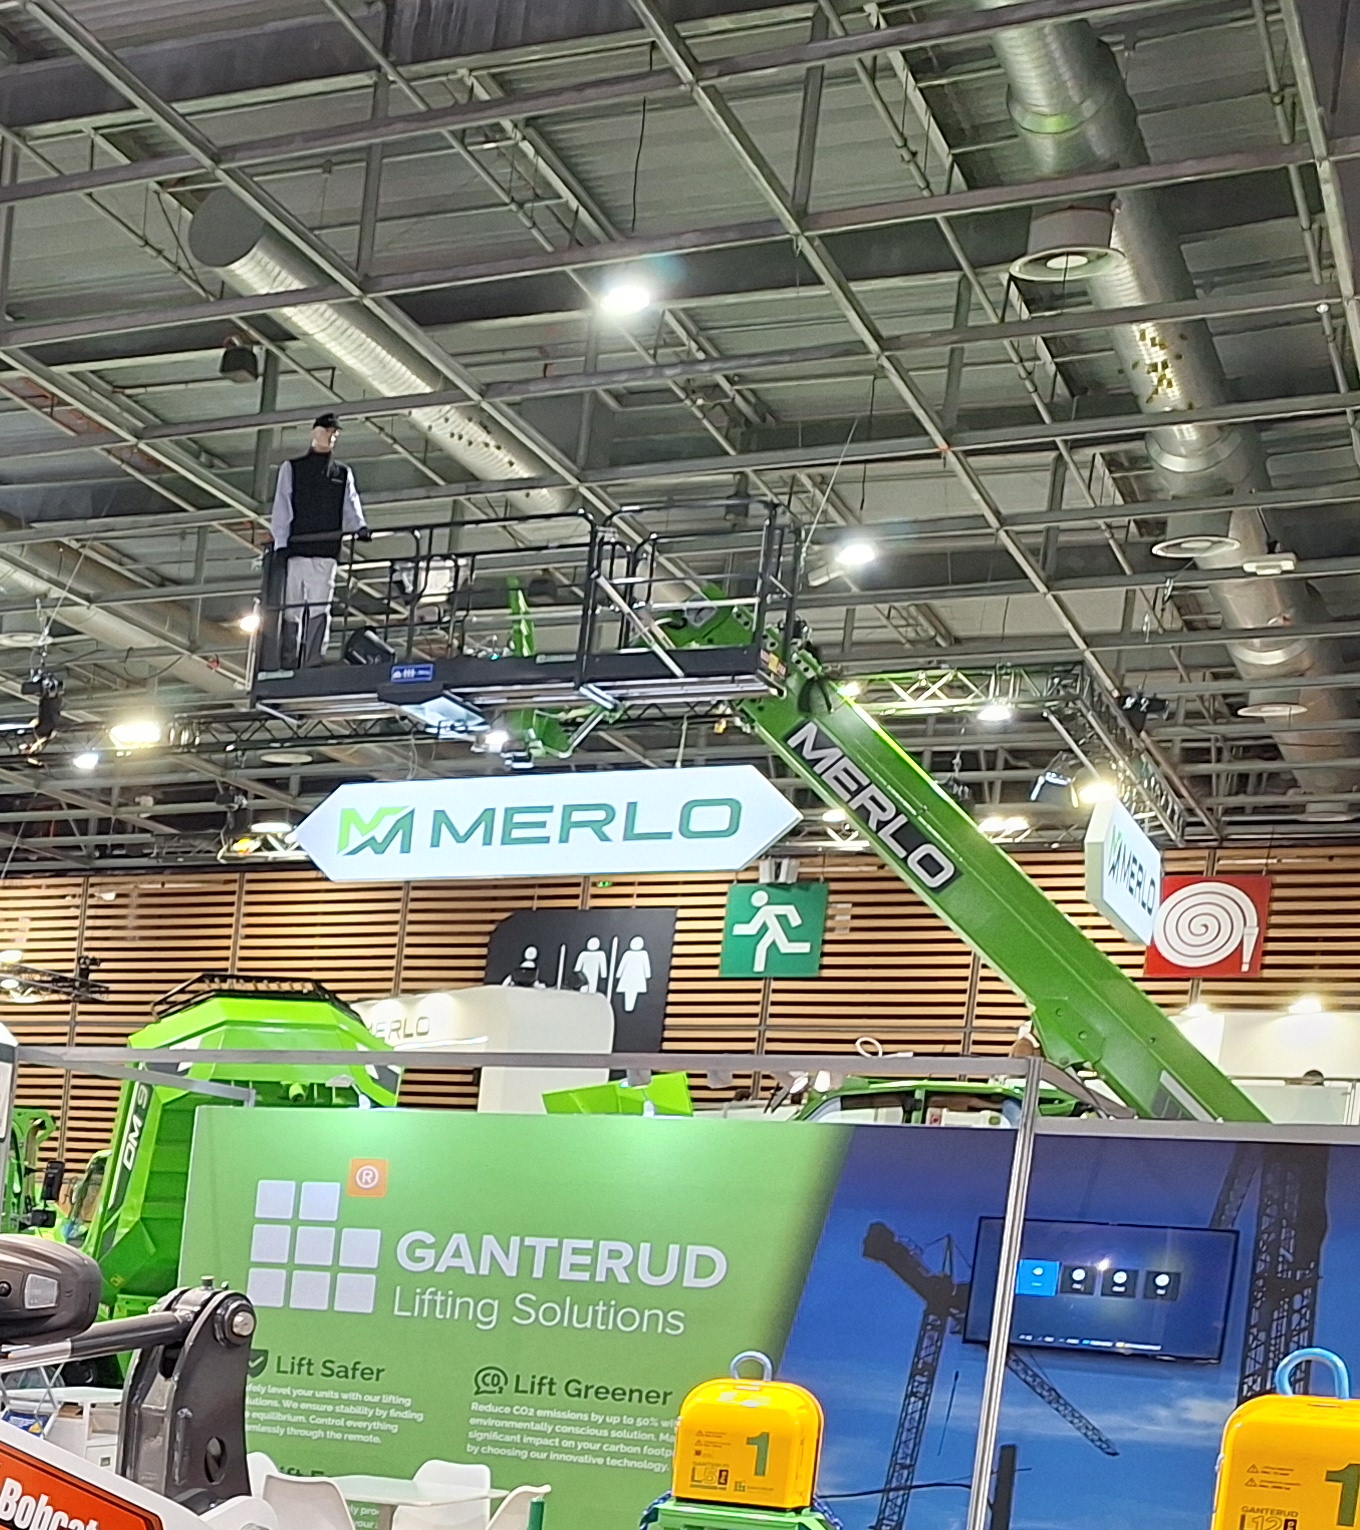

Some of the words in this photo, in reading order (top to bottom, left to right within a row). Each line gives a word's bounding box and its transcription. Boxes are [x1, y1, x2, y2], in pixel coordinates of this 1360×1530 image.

[785, 721, 958, 891] MERLO
[430, 797, 743, 850] MERLO
[1120, 843, 1157, 917] MERLO
[137, 1084, 149, 1109] 9
[395, 1231, 728, 1289] GANTERUD
[393, 1285, 499, 1331] Lifting
[512, 1292, 686, 1336] Solutions
[276, 1355, 314, 1377] Lift
[321, 1359, 385, 1382] Safer
[268, 1384, 291, 1396] level
[292, 1389, 314, 1399] your
[315, 1388, 339, 1400] units
[341, 1391, 362, 1402] with
[364, 1393, 380, 1403] our
[382, 1393, 412, 1408] lifting
[514, 1374, 557, 1398] Lift
[564, 1378, 674, 1406] Greener
[251, 1410, 307, 1425] equilibrium.
[309, 1414, 345, 1427] Control
[346, 1418, 399, 1434] everything
[282, 1399, 299, 1410] We
[300, 1401, 333, 1413] ensure
[335, 1403, 374, 1418] stability
[375, 1406, 388, 1419] by
[389, 1408, 424, 1423] finding
[471, 1401, 510, 1415] Reduce
[512, 1404, 535, 1416] CO2
[536, 1408, 589, 1422] emissions
[591, 1412, 604, 1426] by
[606, 1414, 621, 1426] up
[622, 1414, 634, 1426] to
[635, 1416, 659, 1428] 50%
[287, 1425, 324, 1440] through
[326, 1429, 342, 1441] the
[344, 1431, 382, 1444] remote.
[468, 1429, 521, 1443] significant
[523, 1434, 559, 1449] impact
[561, 1439, 575, 1449] on
[577, 1440, 601, 1453] your
[603, 1440, 641, 1455] carbon
[469, 1416, 554, 1434] environmentally
[555, 1423, 609, 1438] conscious
[610, 1428, 656, 1443] solution.
[466, 1442, 480, 1455] by
[481, 1444, 528, 1460] choosing
[530, 1449, 547, 1460] our
[549, 1451, 605, 1466] innovative
[606, 1455, 671, 1473] technology.
[745, 1431, 771, 1477] 1
[1241, 1505, 1299, 1517] GANTERUD
